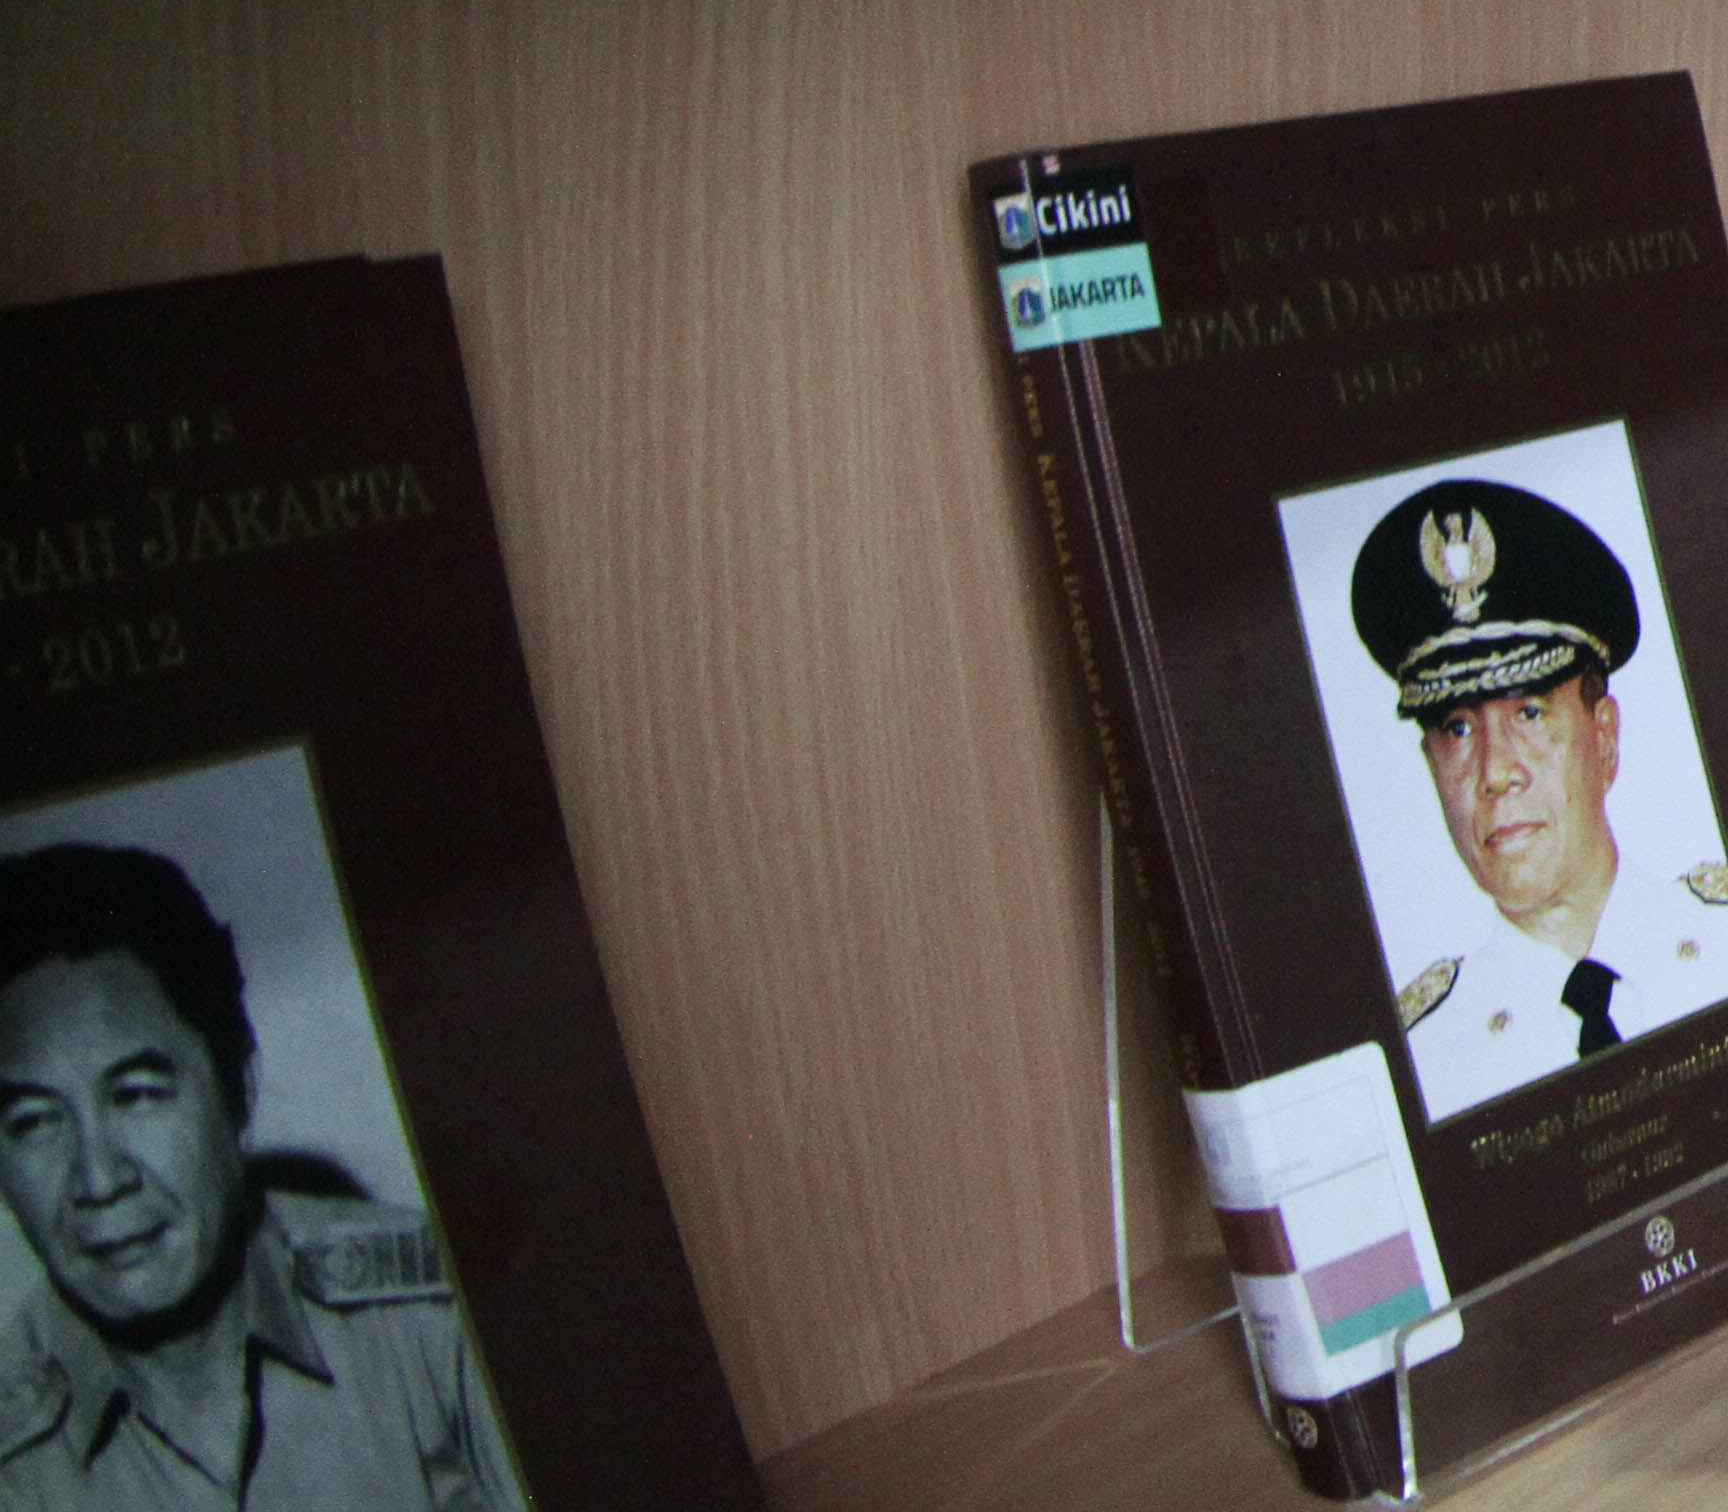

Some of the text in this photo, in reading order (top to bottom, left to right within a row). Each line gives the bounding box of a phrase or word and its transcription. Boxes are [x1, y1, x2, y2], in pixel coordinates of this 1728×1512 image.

[1036, 184, 1132, 236] Cikini
[1050, 273, 1147, 313] JAKARTA
[1112, 226, 1701, 375] KEPALA DAERAH JAKARTA
[140, 460, 437, 572] JAKARTA
[41, 613, 189, 696] 2012
[1639, 1248, 1699, 1294] BKKI
